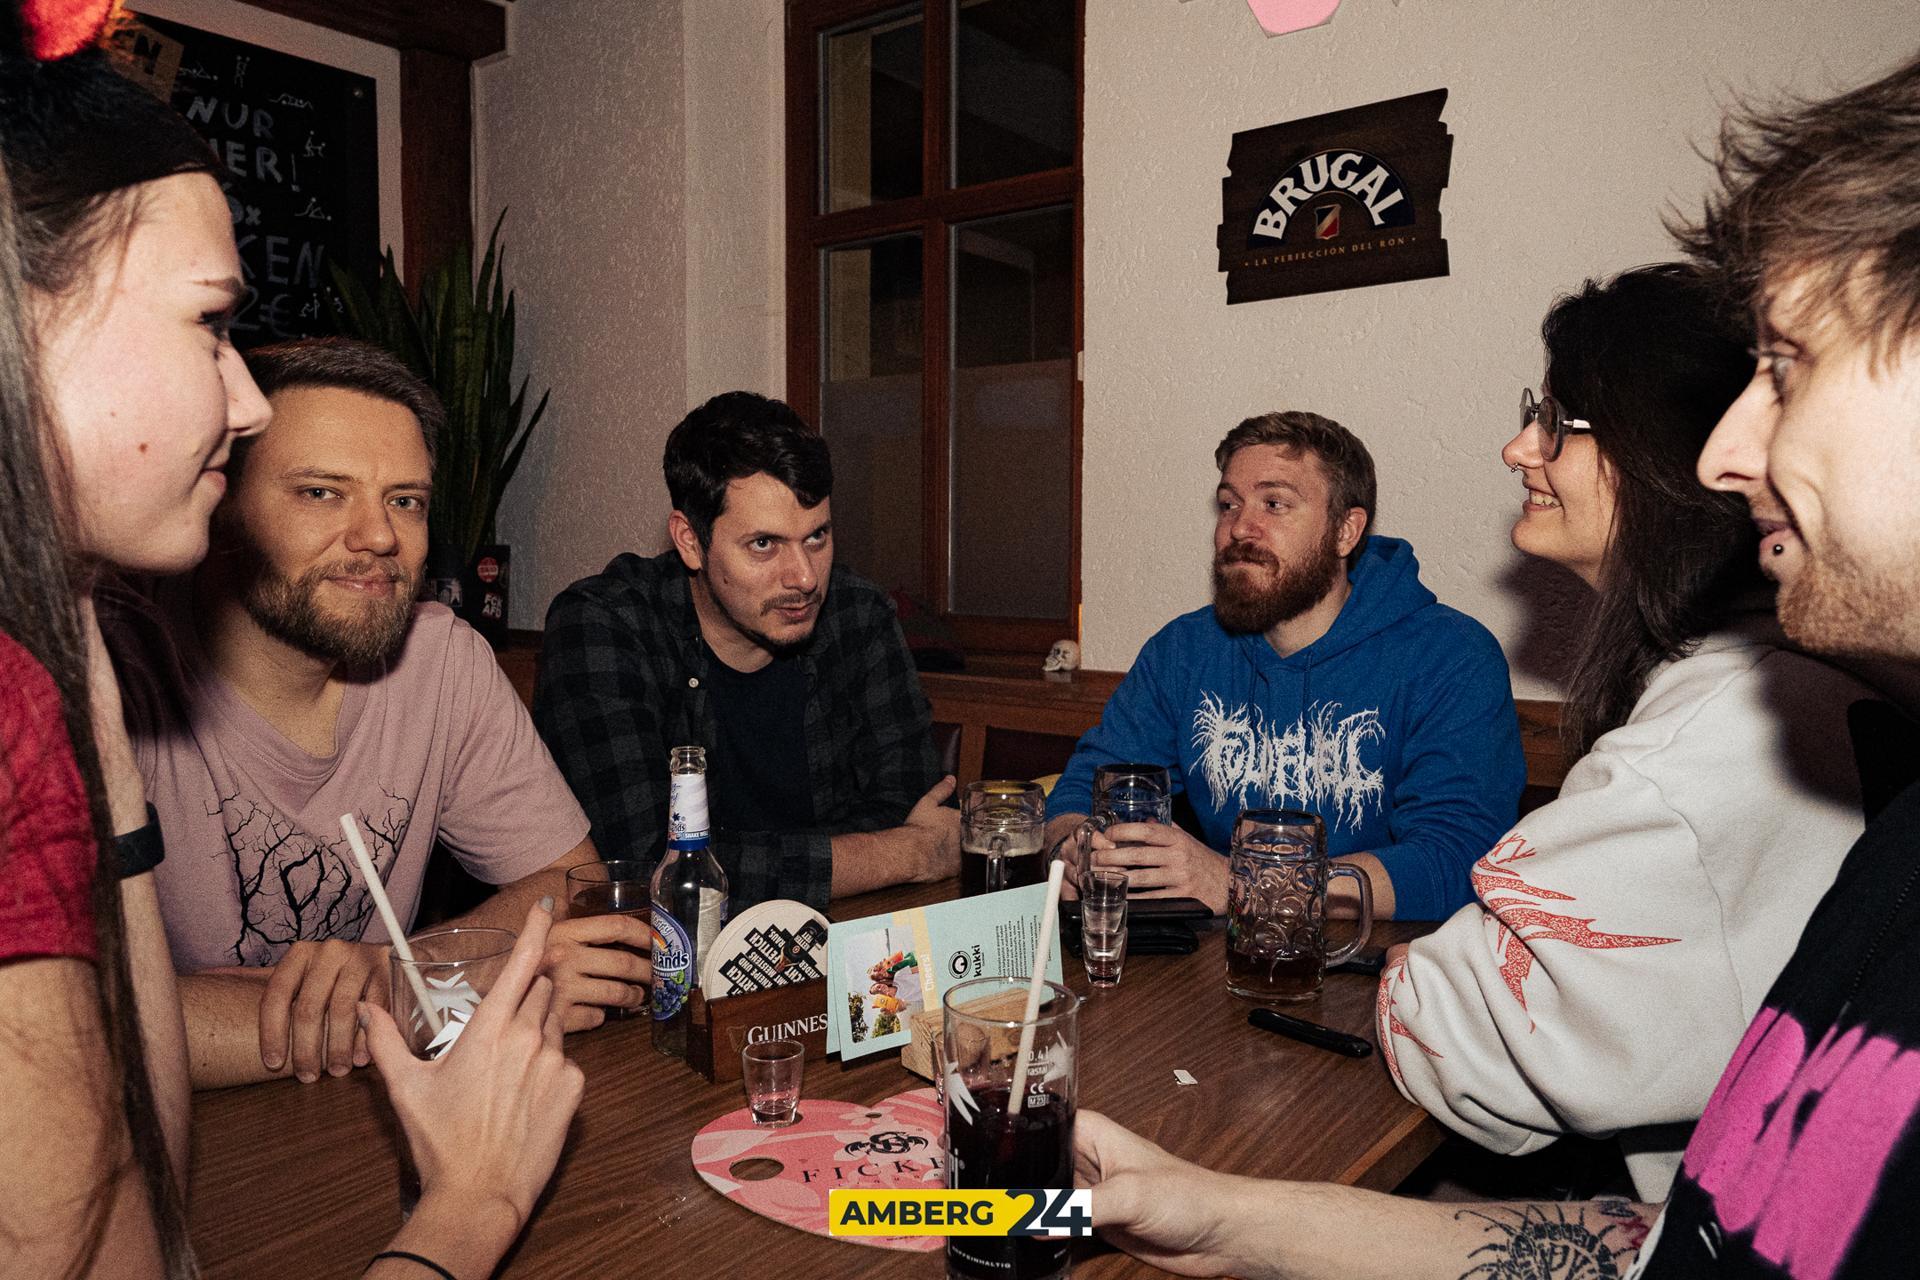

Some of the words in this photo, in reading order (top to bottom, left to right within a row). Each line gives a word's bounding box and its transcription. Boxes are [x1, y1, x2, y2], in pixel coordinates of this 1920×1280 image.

[186, 96, 275, 139] NUR
[1253, 152, 1404, 239] BRUGAL
[1254, 257, 1268, 266] LA
[1352, 242, 1373, 252] DEL
[1379, 237, 1406, 249] RON
[749, 931, 782, 964] FETTICH
[971, 944, 983, 978] kukki
[738, 957, 753, 971] UND
[748, 951, 777, 977] MEISTENS
[747, 1013, 828, 1044] GUINNES
